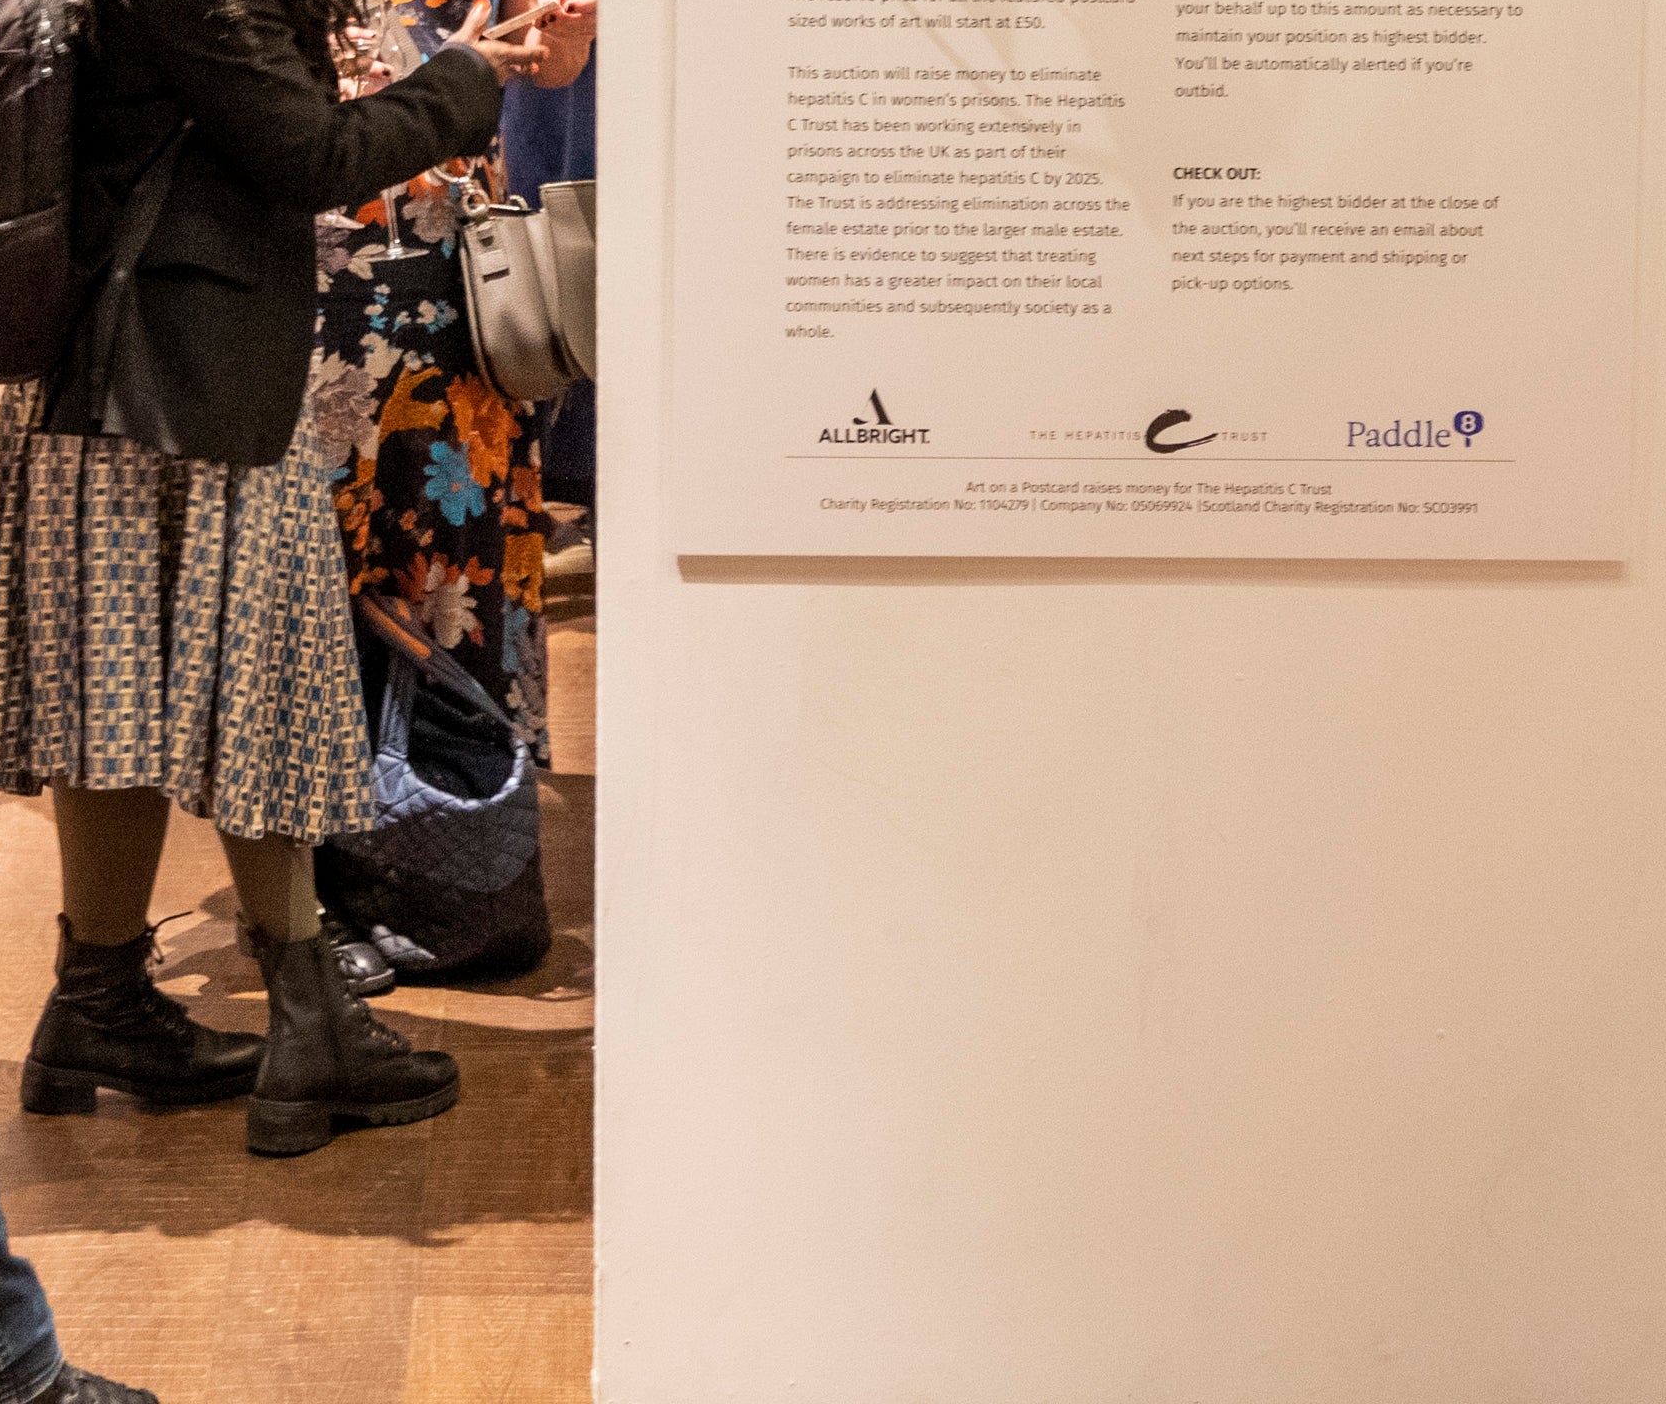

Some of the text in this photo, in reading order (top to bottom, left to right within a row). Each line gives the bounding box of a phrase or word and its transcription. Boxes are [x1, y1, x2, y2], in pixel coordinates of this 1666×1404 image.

[788, 14, 1045, 29] sized works of art will start at £50.
[788, 66, 1101, 84] This auction will raise money to eliminate
[1173, 167, 1260, 180] CHECK OUT:
[1173, 194, 1500, 211] If you are the highest bidder at the close of
[1030, 430, 1057, 441] THE
[1065, 430, 1142, 441] HEPATITIS
[1221, 432, 1268, 442] TRUST
[965, 479, 1332, 498] Art on a Postcard raises money for The Hepatitis C Trust
